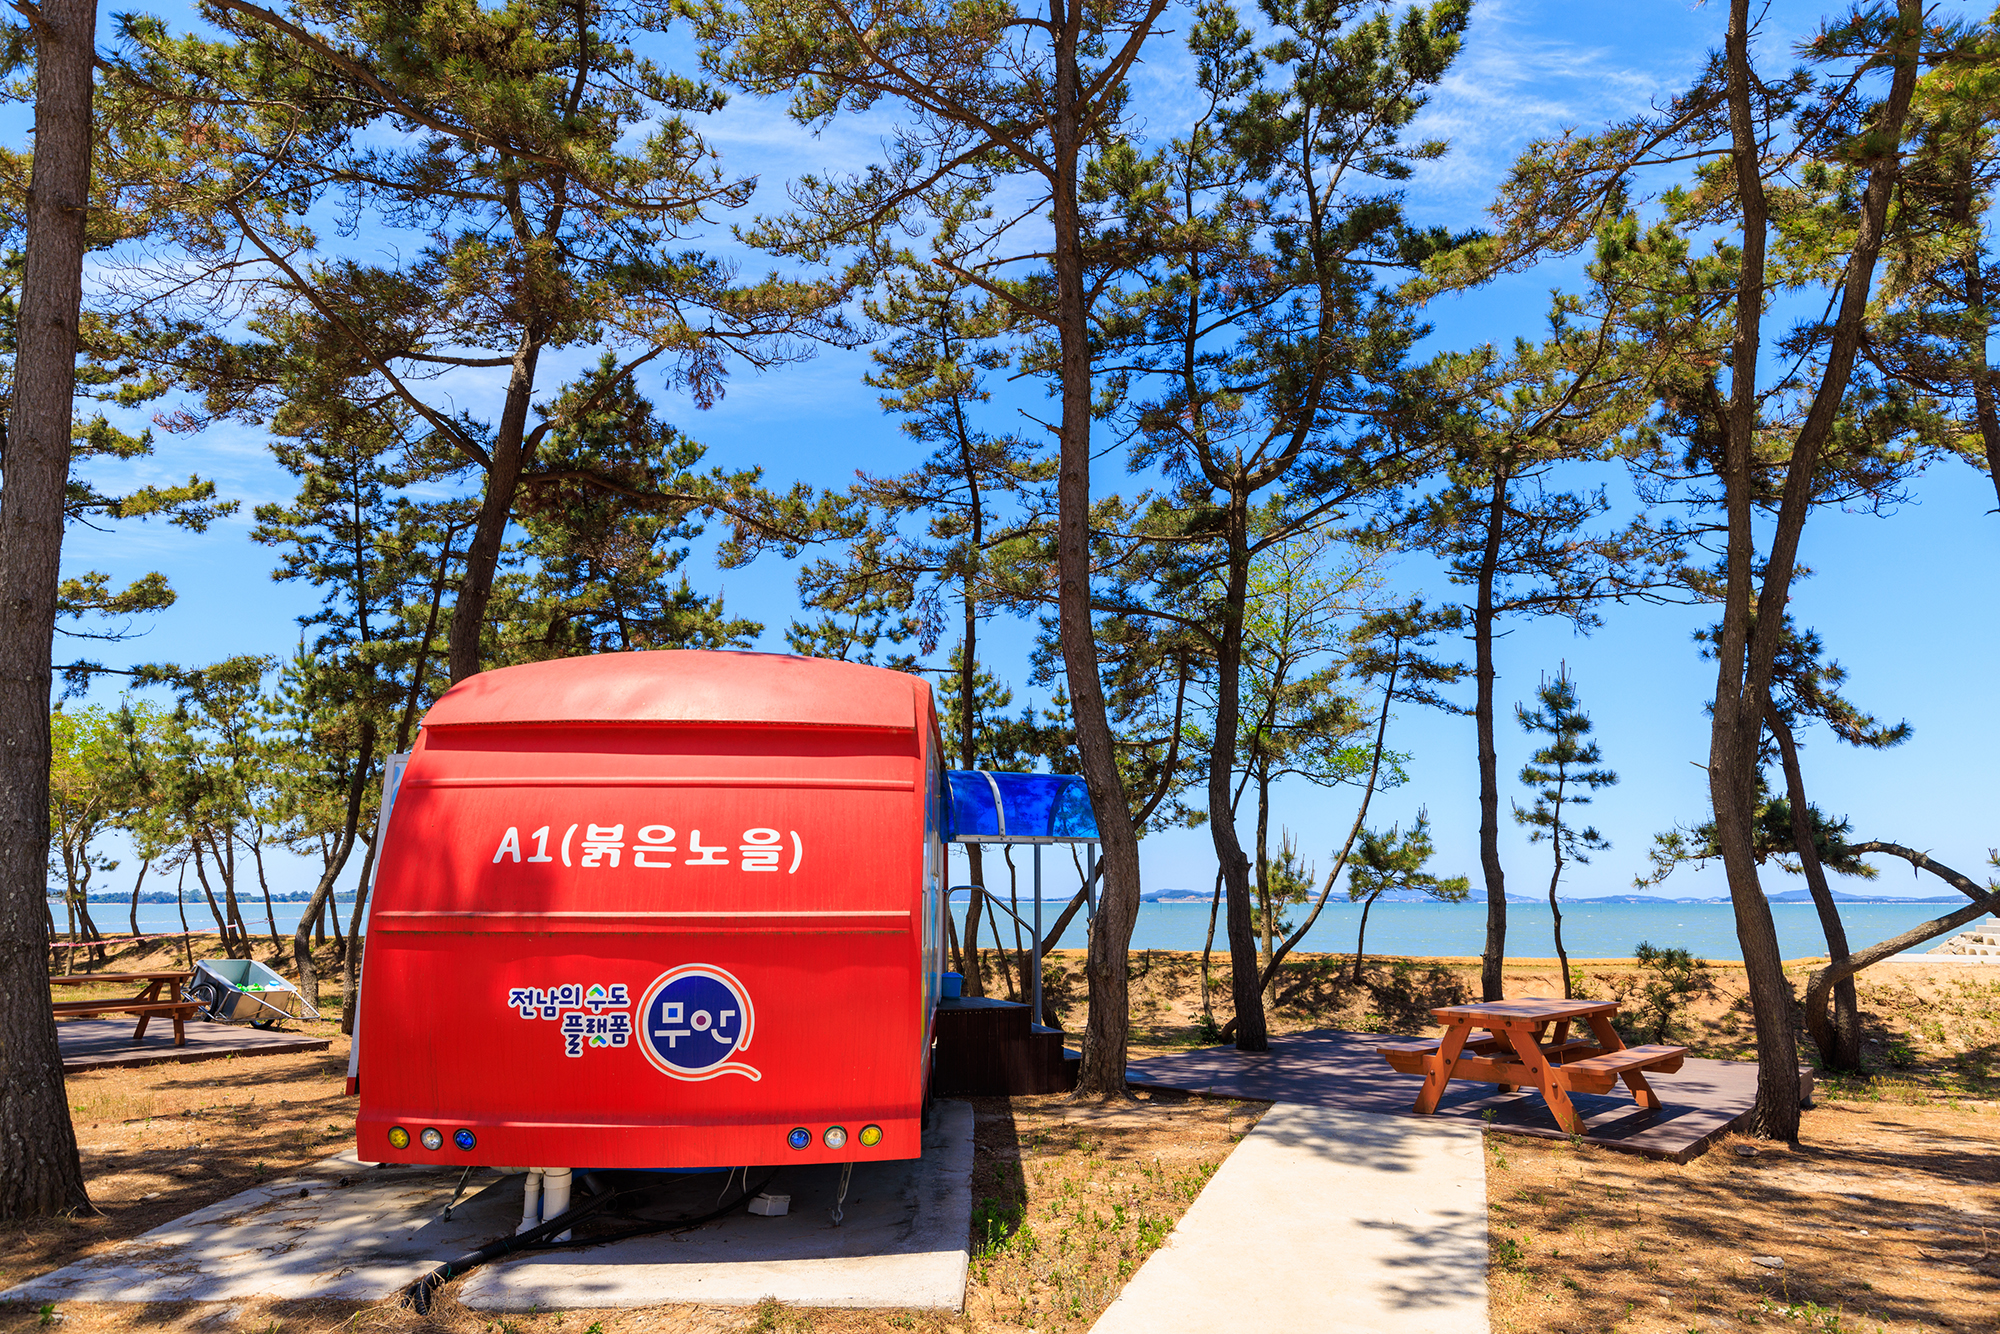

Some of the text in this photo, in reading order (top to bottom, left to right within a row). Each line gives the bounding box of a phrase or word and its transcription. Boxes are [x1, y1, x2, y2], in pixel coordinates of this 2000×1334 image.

[509, 985, 629, 1018] 전남의 수도
[562, 1014, 631, 1056] 플랫폼
[654, 1002, 736, 1048] 무안
